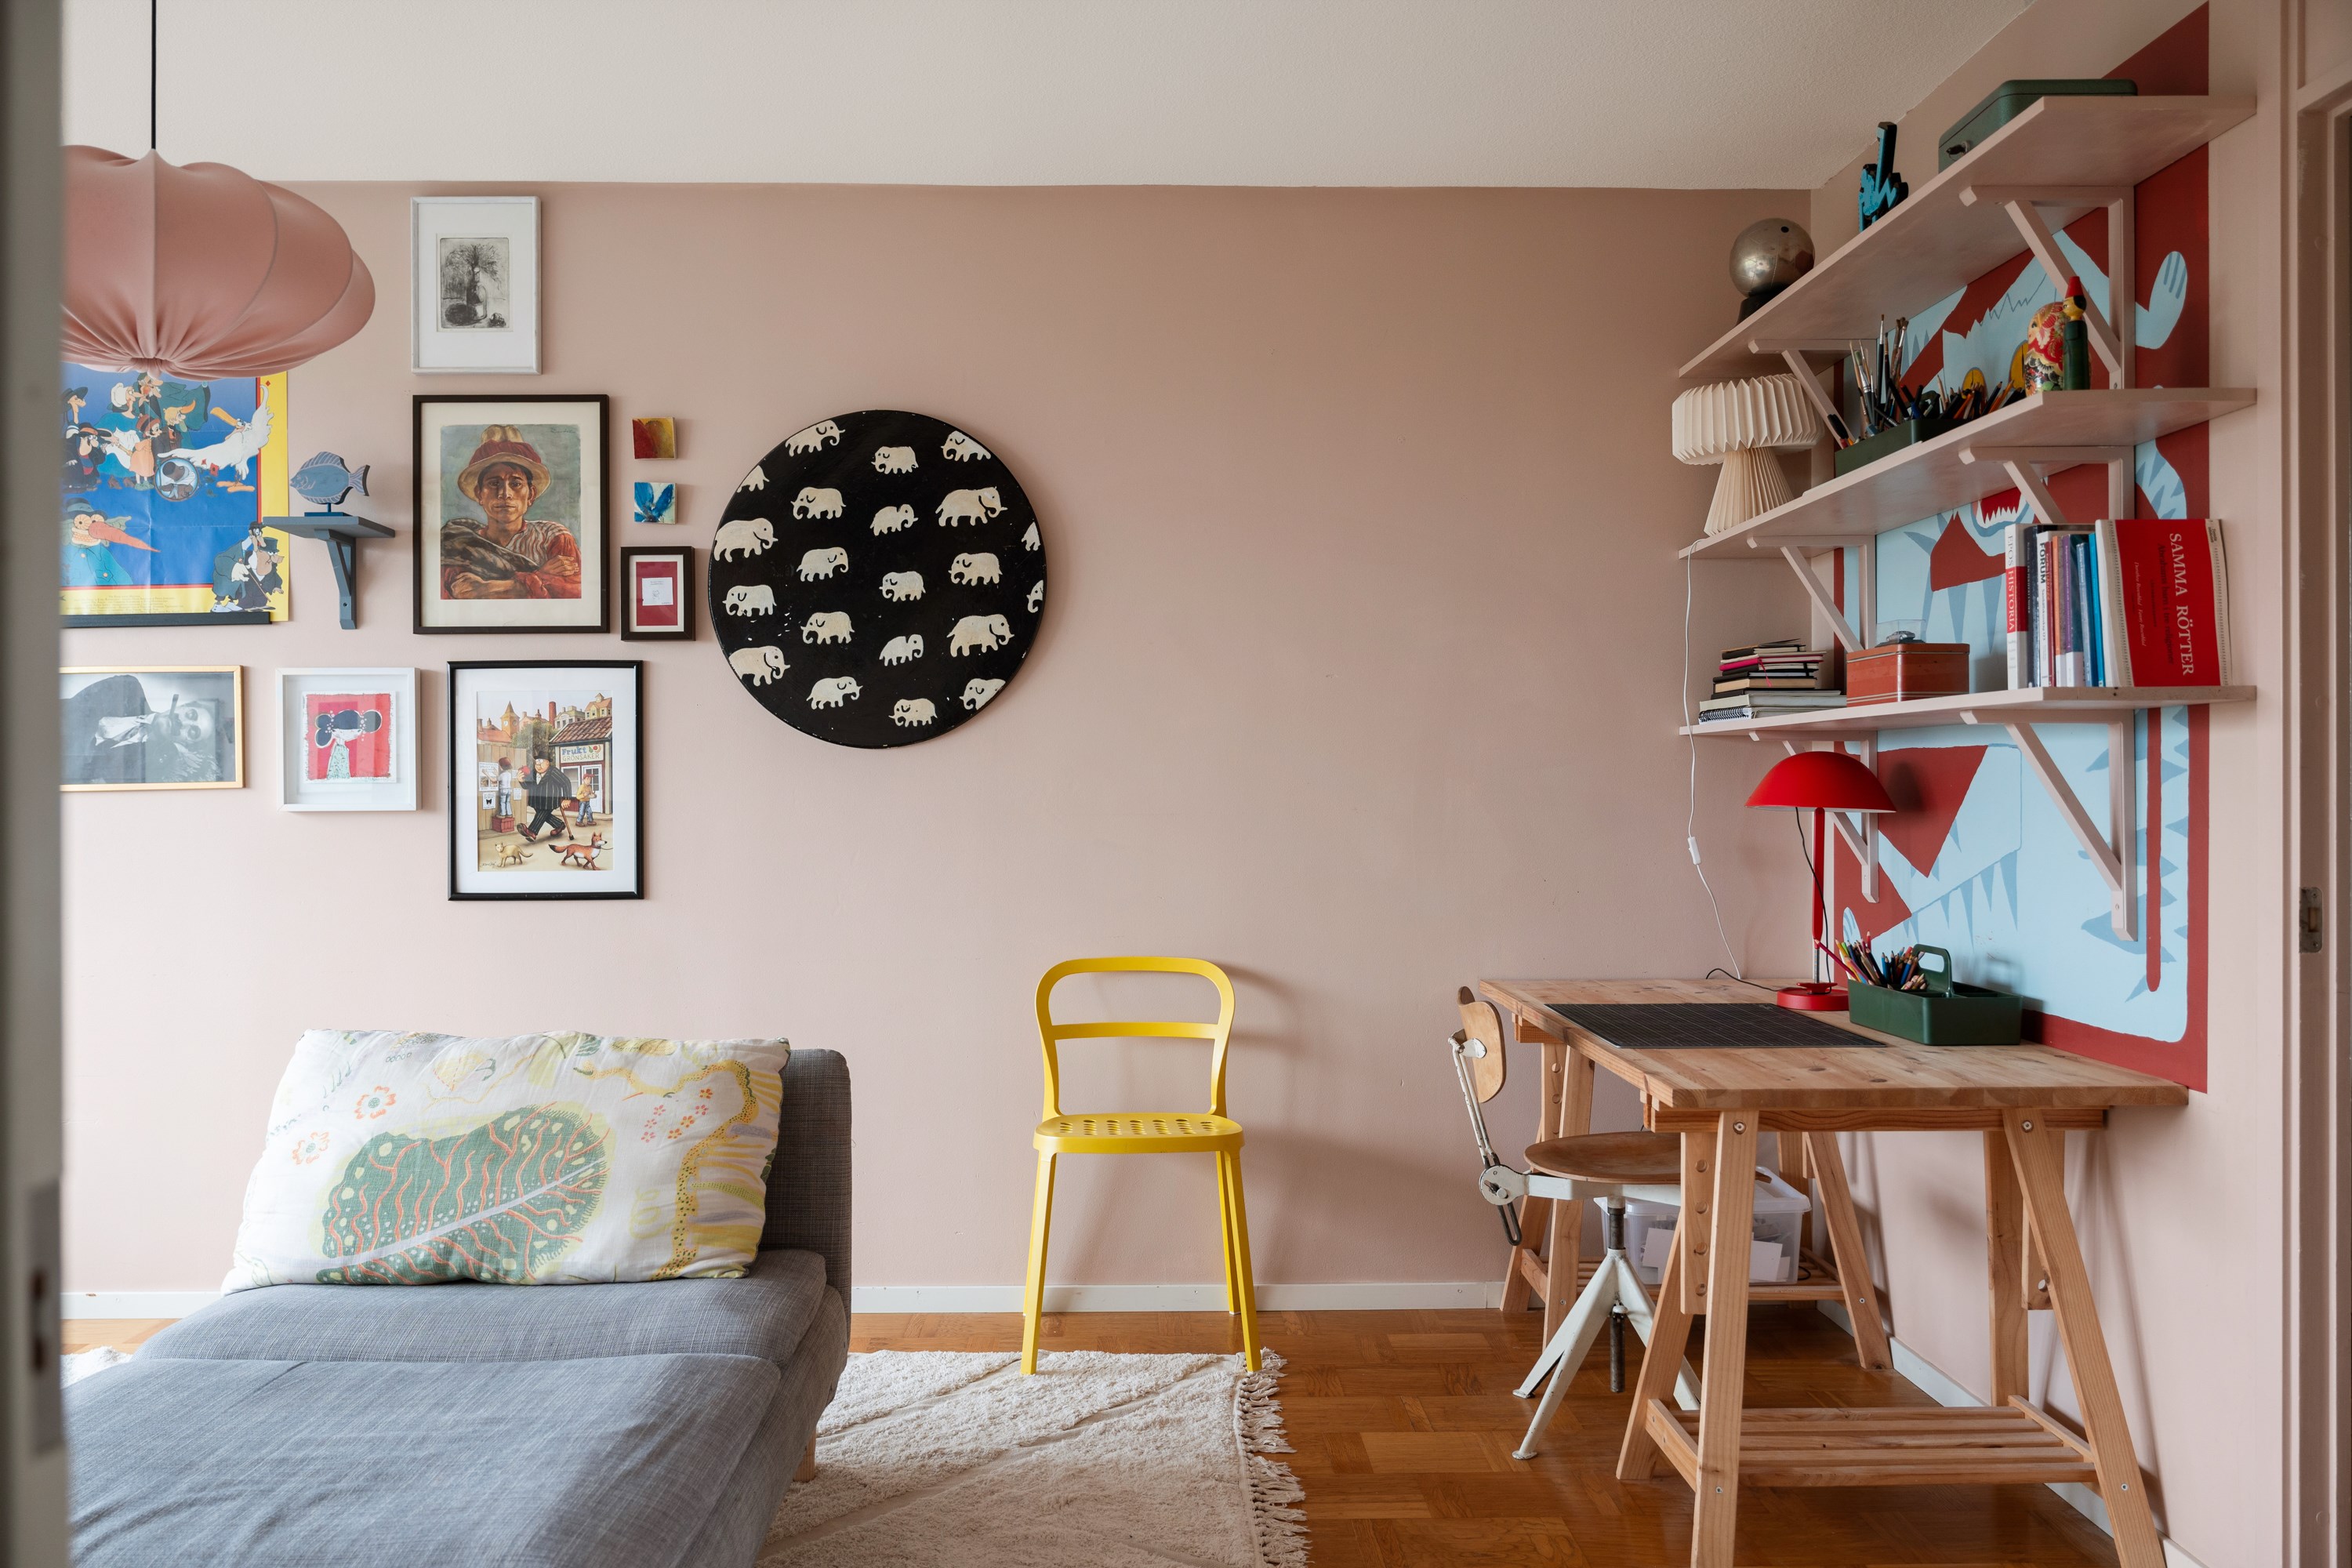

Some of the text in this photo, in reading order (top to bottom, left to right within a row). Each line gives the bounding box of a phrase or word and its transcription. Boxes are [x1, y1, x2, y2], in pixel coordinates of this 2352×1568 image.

[2169, 533, 2194, 676] SAMMA RÖTTER
[562, 746, 586, 755] Frukt
